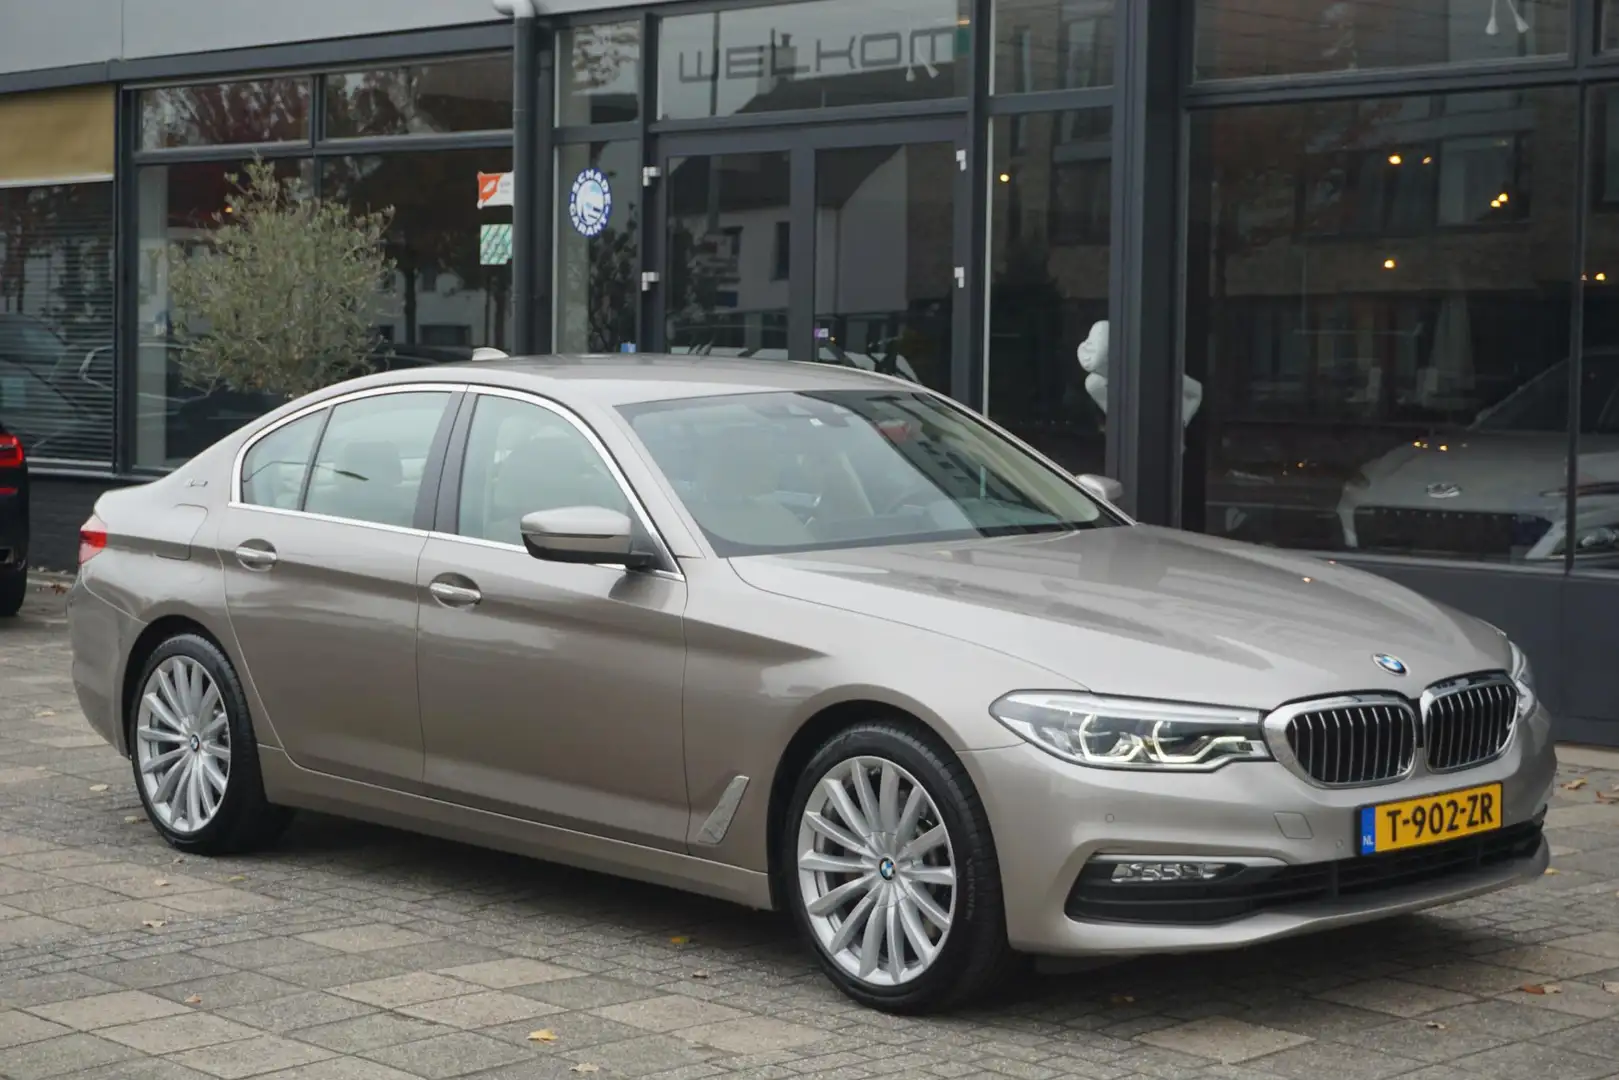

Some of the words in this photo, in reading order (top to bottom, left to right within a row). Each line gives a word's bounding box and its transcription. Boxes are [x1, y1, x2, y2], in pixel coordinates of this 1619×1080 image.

[679, 26, 954, 83] WELKOM
[572, 168, 611, 205] SCHADE
[569, 203, 607, 236] GARANT
[1386, 792, 1493, 842] T-902-ZR
[1362, 835, 1374, 846] NL
